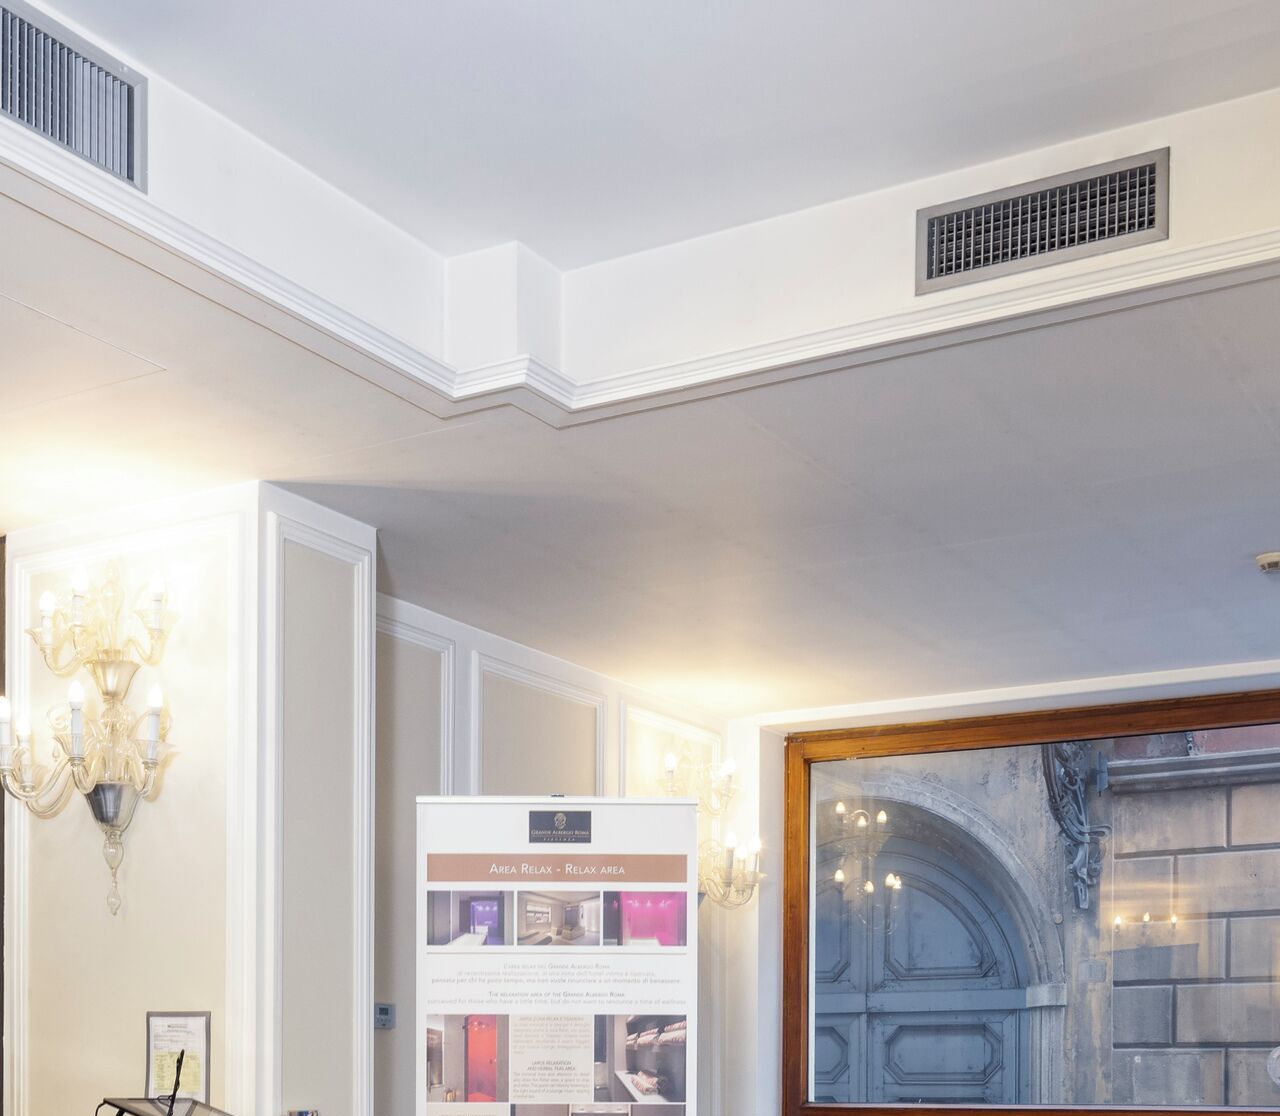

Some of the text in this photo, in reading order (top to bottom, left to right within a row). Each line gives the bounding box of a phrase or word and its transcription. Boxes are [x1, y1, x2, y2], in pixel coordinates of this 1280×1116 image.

[489, 863, 517, 874] AREA
[521, 863, 552, 874] RELAX
[565, 863, 596, 874] RELAX
[600, 865, 625, 874] AREA
